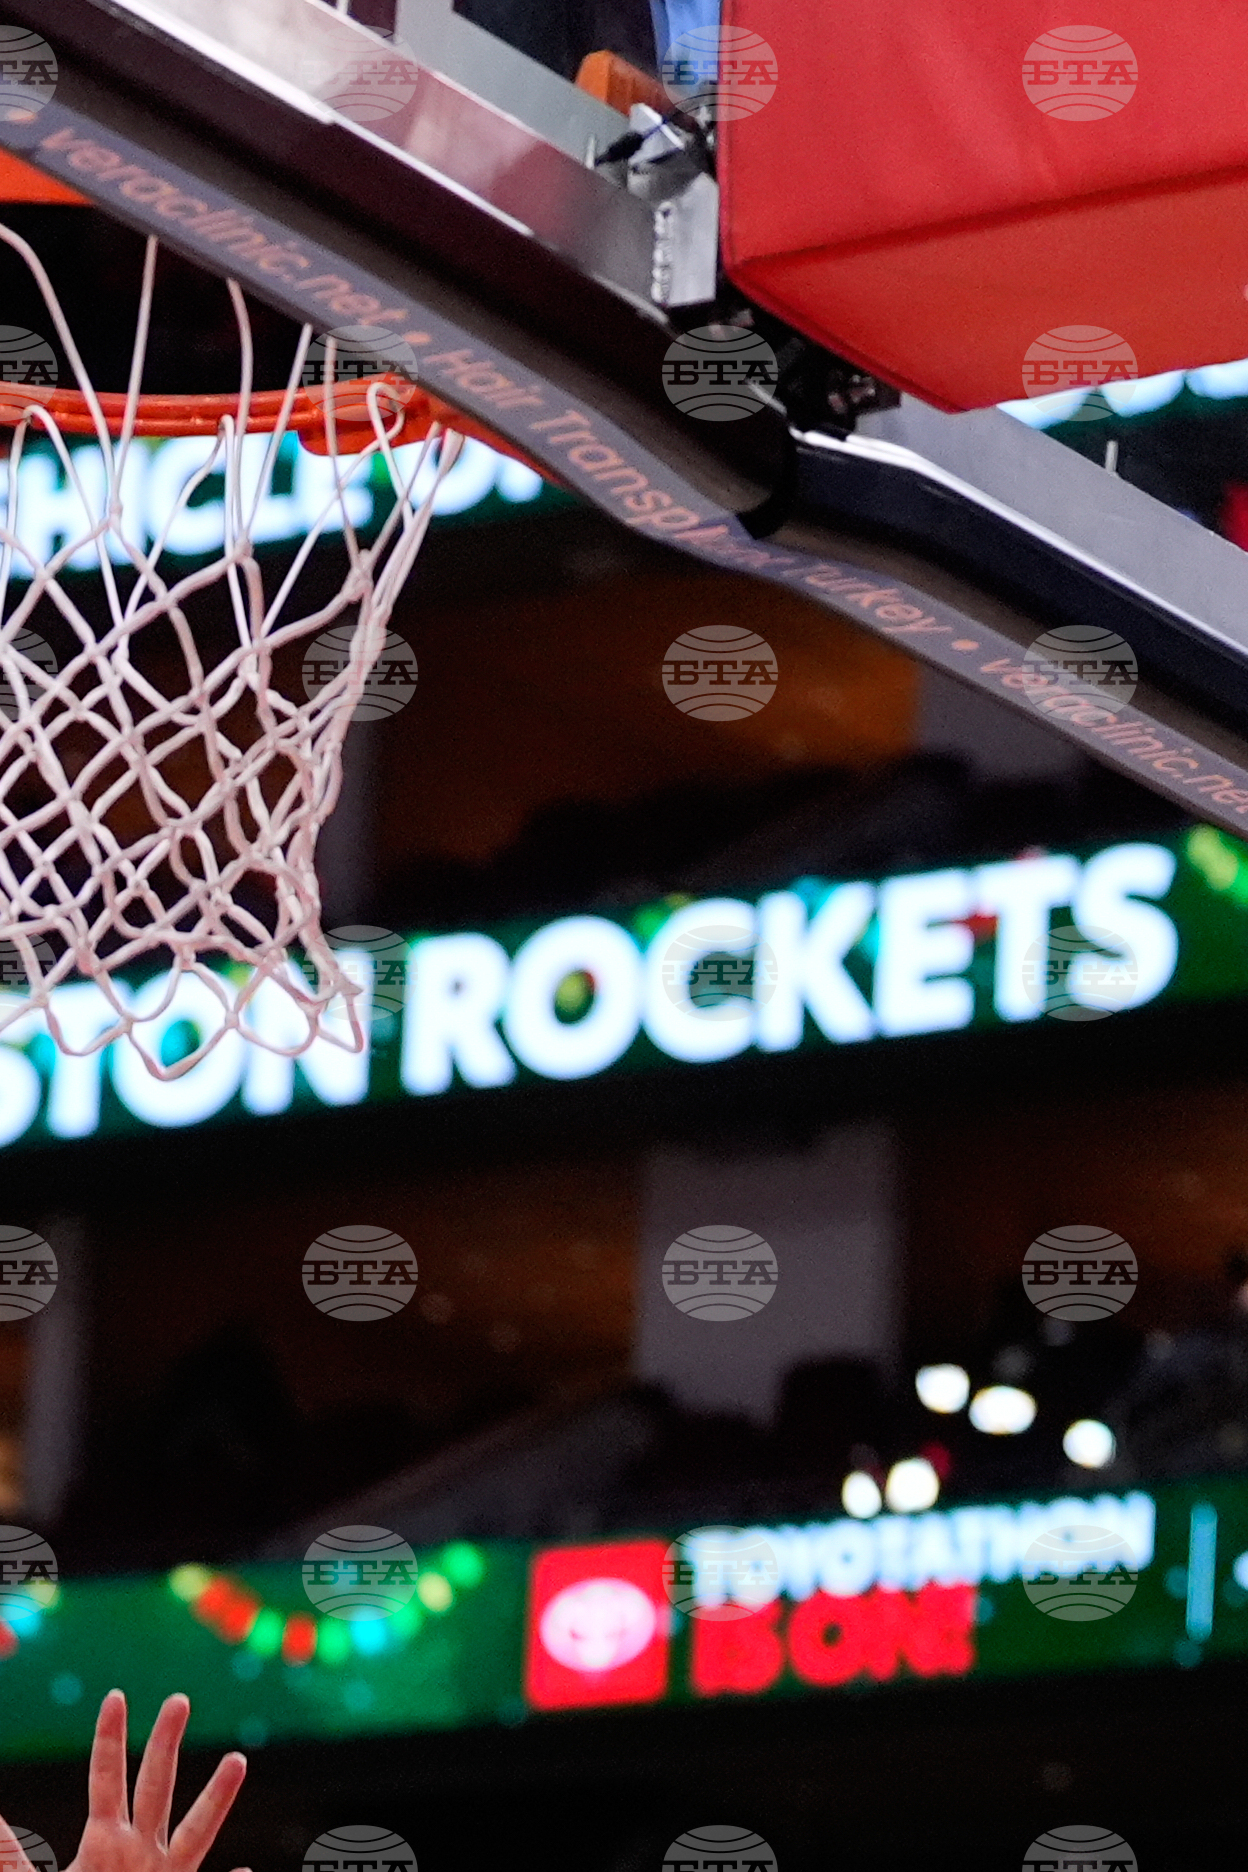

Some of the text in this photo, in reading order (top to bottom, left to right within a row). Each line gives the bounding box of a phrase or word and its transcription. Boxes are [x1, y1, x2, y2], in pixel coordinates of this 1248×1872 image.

[41, 128, 409, 326] veraclinic.net
[423, 348, 544, 410] Hair
[980, 657, 1248, 814] veraclinic.ne
[400, 841, 1181, 1097] ROCKETS
